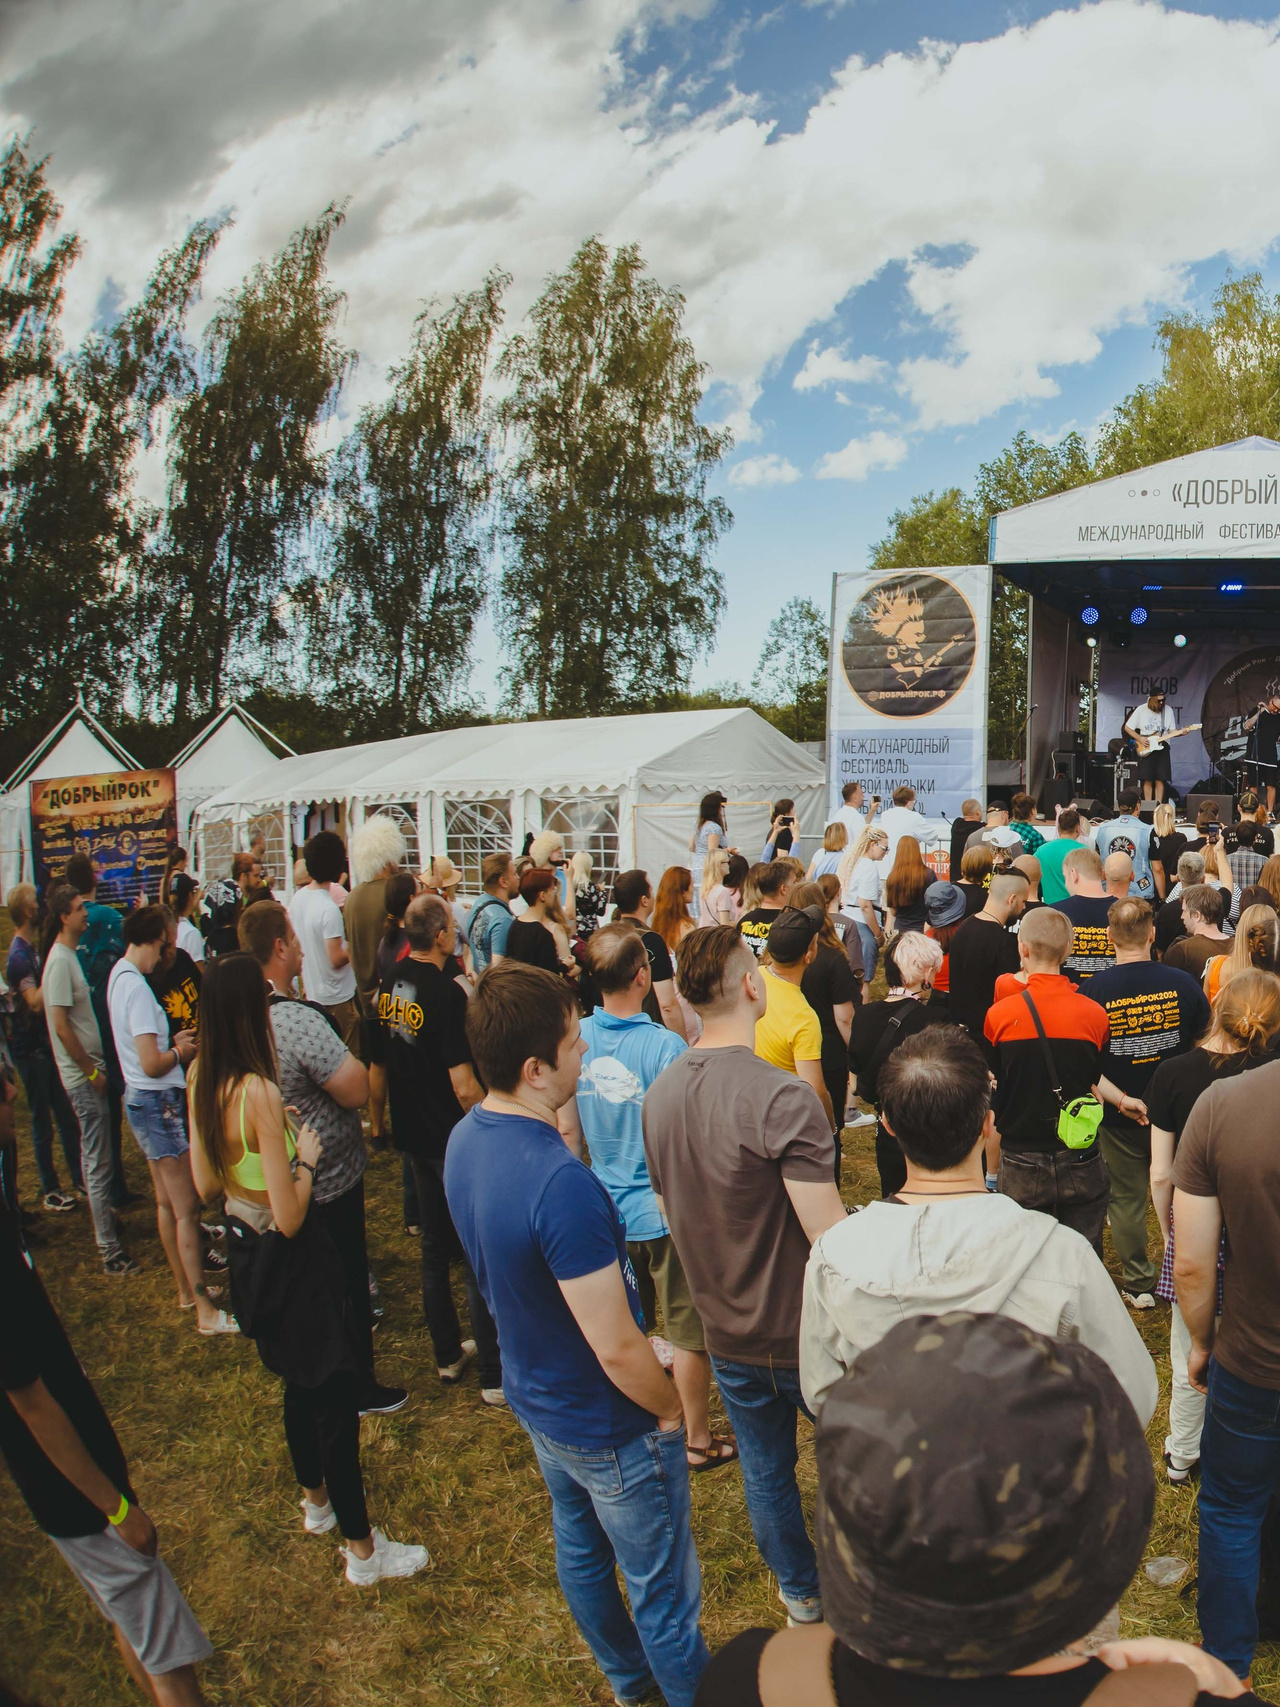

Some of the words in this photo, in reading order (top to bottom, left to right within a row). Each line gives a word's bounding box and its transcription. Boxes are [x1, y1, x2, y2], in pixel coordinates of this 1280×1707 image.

[1172, 474, 1277, 508] «ДОБРЫЙ
[1078, 521, 1204, 542] МЕЖДУНАРОДНЫЙ
[1130, 676, 1178, 695] ПСКОВ
[841, 735, 949, 755] МЕЖДУНАРОДНЫЙ
[841, 758, 909, 774] ФЕСТИВАЛЬ
[842, 776, 881, 794] ВОЙ
